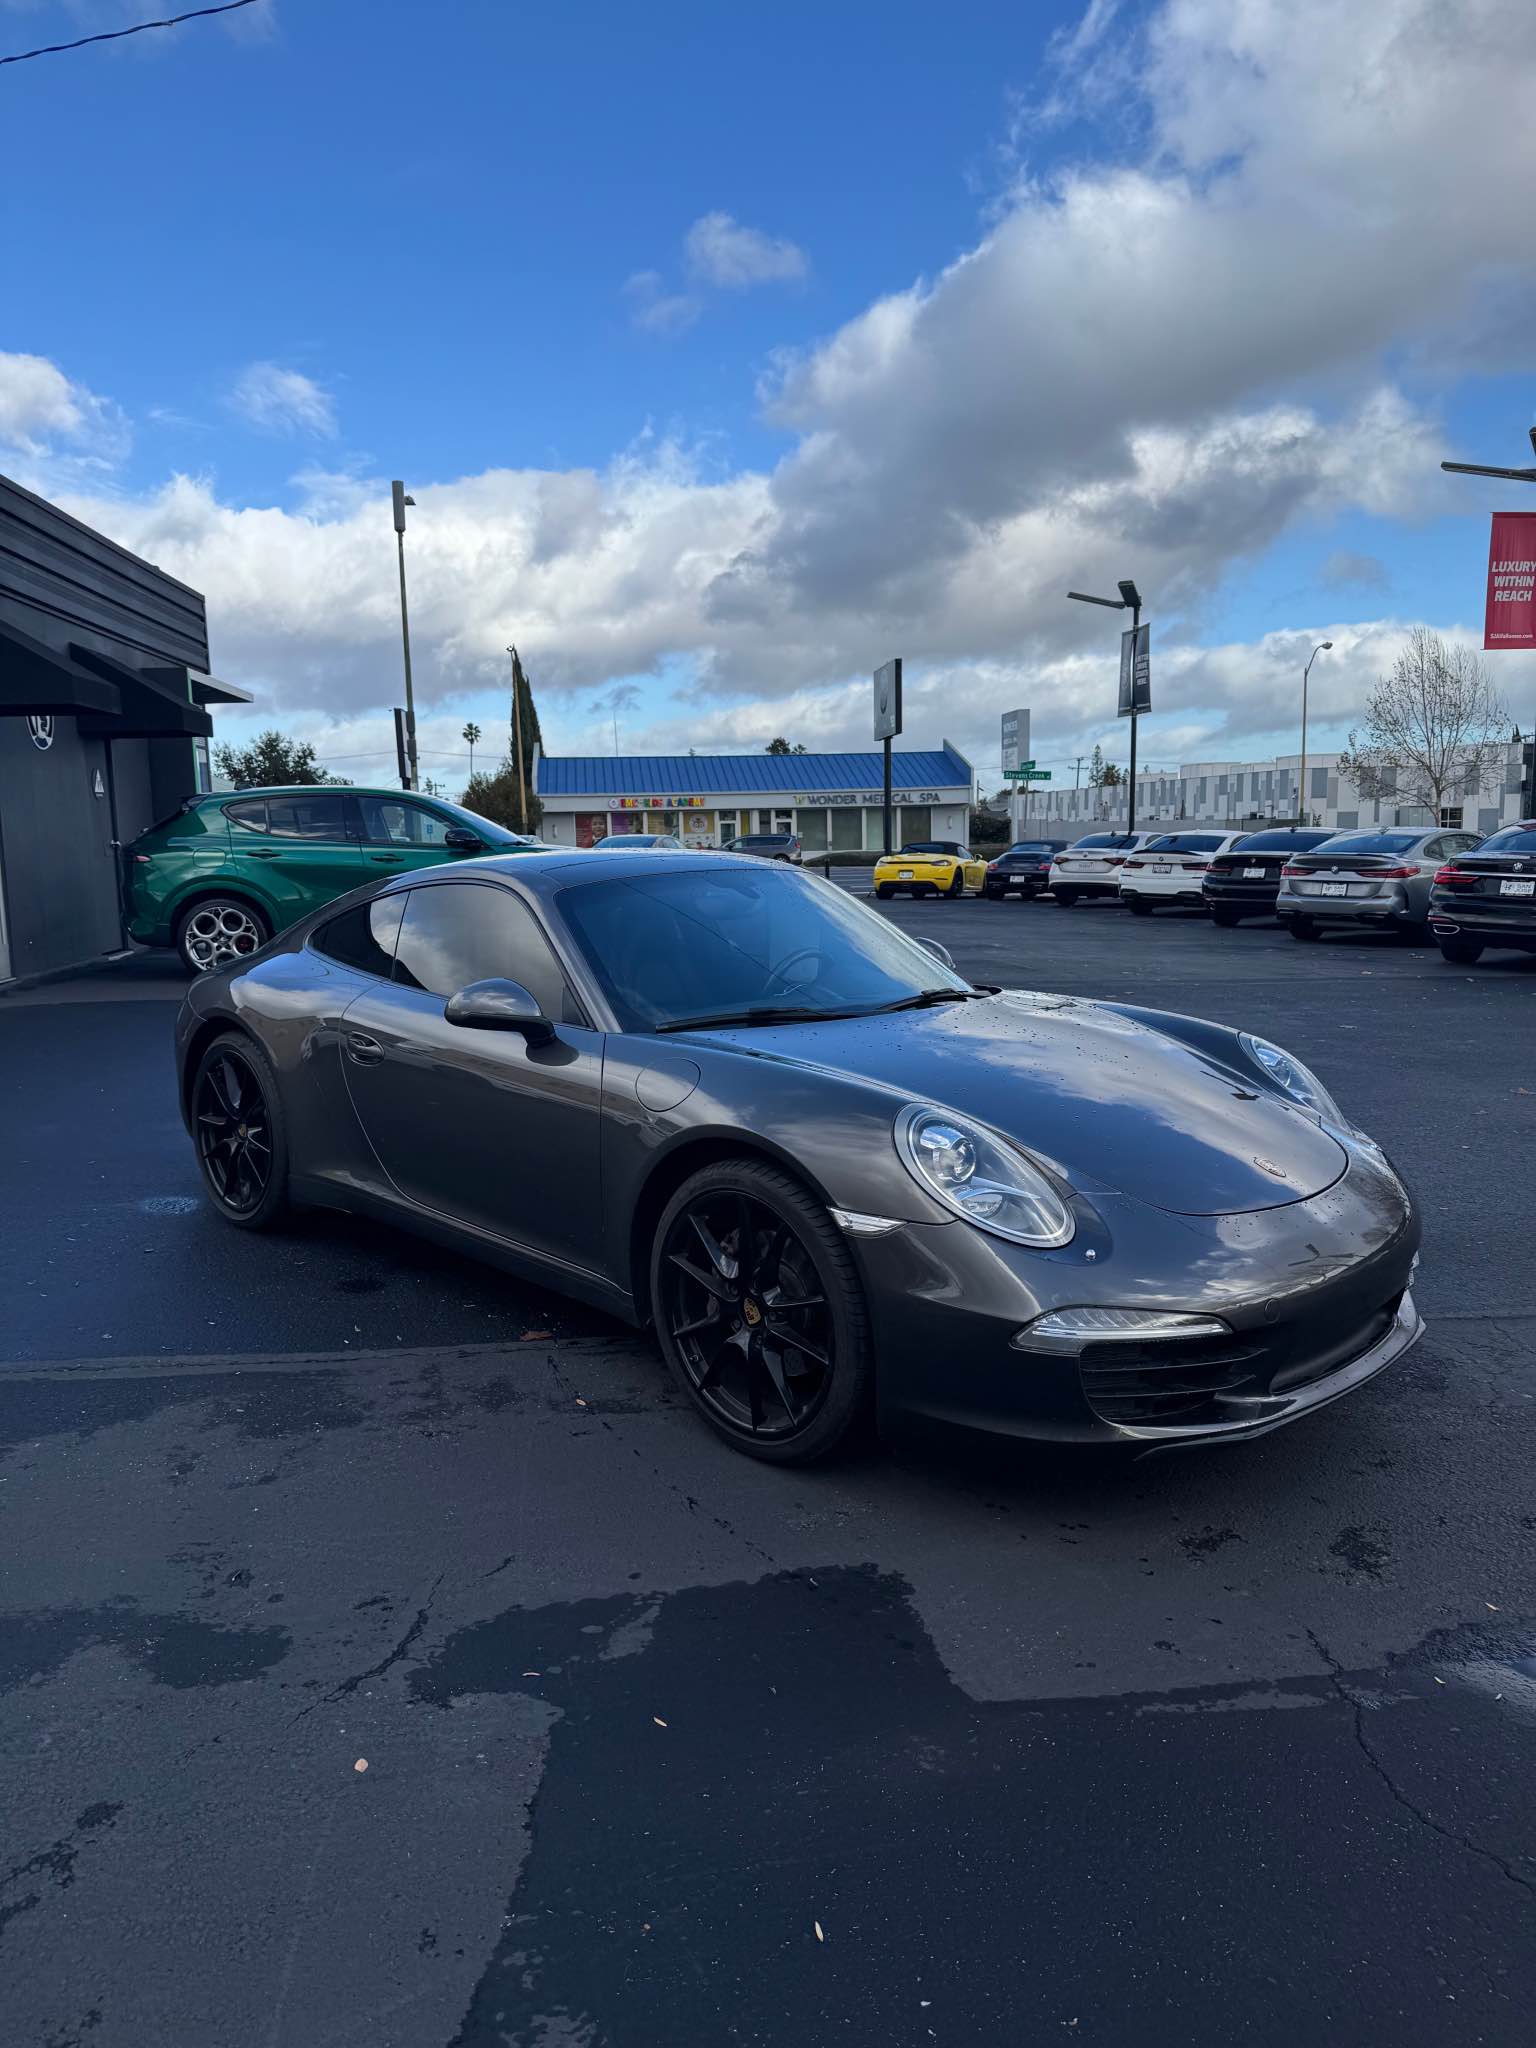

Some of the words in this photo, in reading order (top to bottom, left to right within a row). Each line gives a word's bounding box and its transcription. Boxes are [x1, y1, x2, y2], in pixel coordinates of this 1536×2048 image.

[1492, 561, 1536, 572] LUXURY
[1494, 575, 1535, 587] WITHIN
[1495, 590, 1532, 602] REACH
[808, 795, 857, 805] WONDER
[862, 793, 913, 804] MEDCAL
[919, 793, 940, 803] SPA
